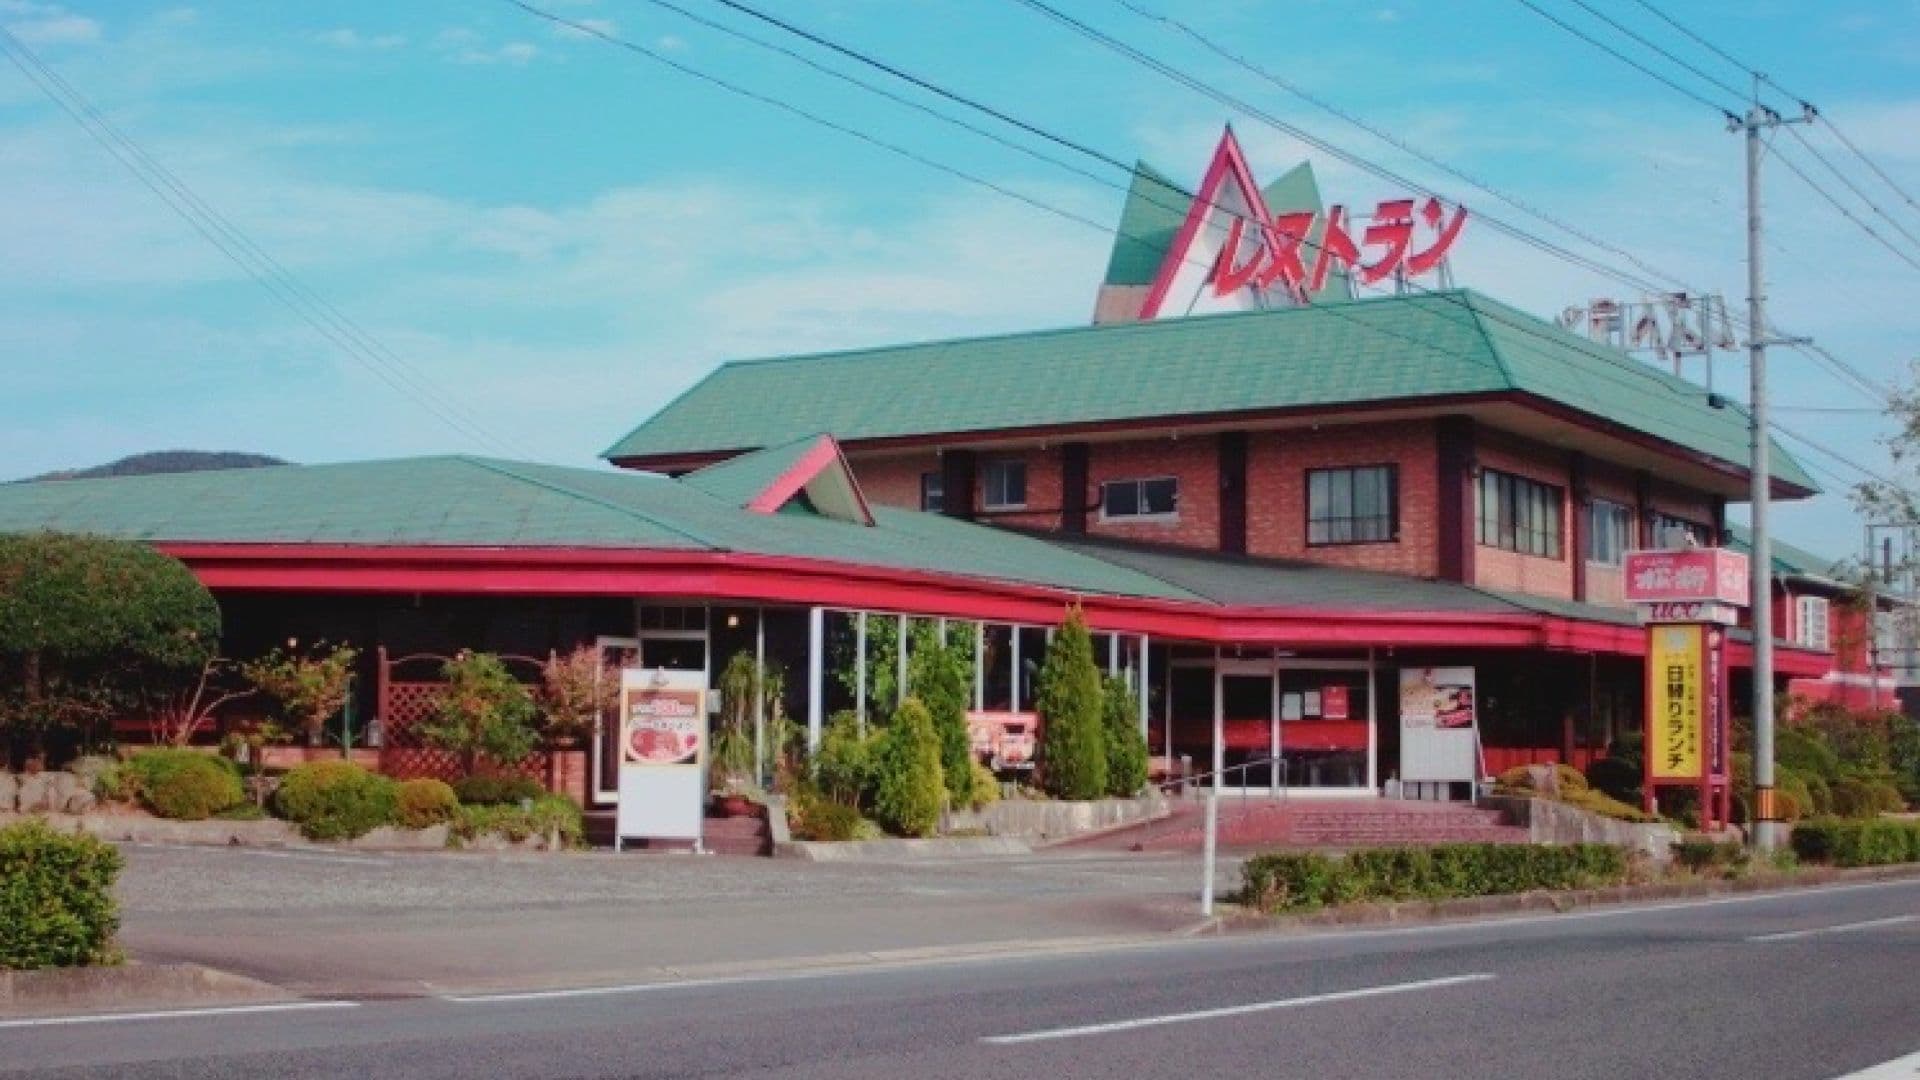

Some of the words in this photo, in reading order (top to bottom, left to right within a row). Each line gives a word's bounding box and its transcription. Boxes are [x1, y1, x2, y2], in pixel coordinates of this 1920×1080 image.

[1209, 197, 1468, 301] レストラン
[1667, 665, 1685, 769] 日替りランチ
